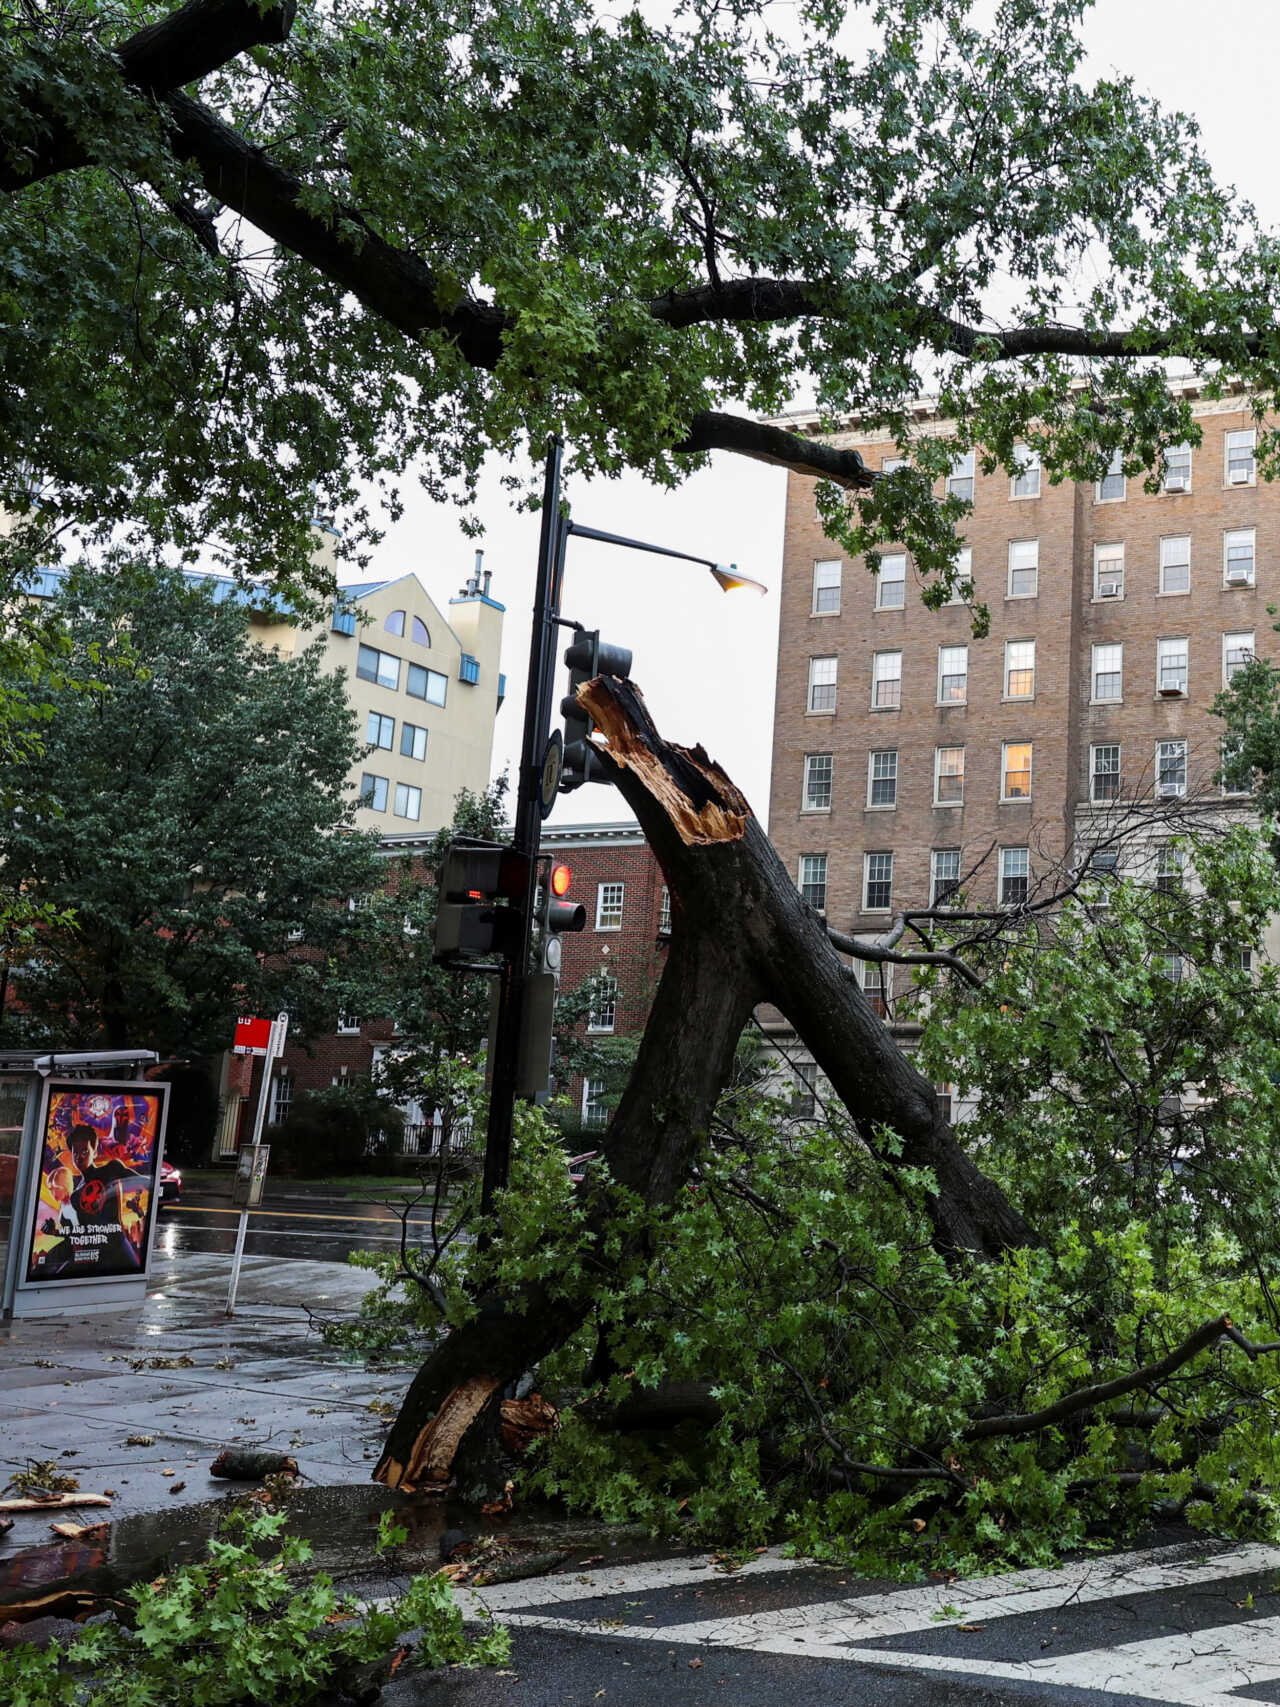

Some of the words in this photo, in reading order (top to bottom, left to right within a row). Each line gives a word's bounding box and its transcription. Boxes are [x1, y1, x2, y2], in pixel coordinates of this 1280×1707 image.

[59, 1226, 71, 1235] WE
[72, 1224, 86, 1234] ARE
[87, 1223, 122, 1234] STRONGER
[70, 1234, 108, 1245] TOGETHER
